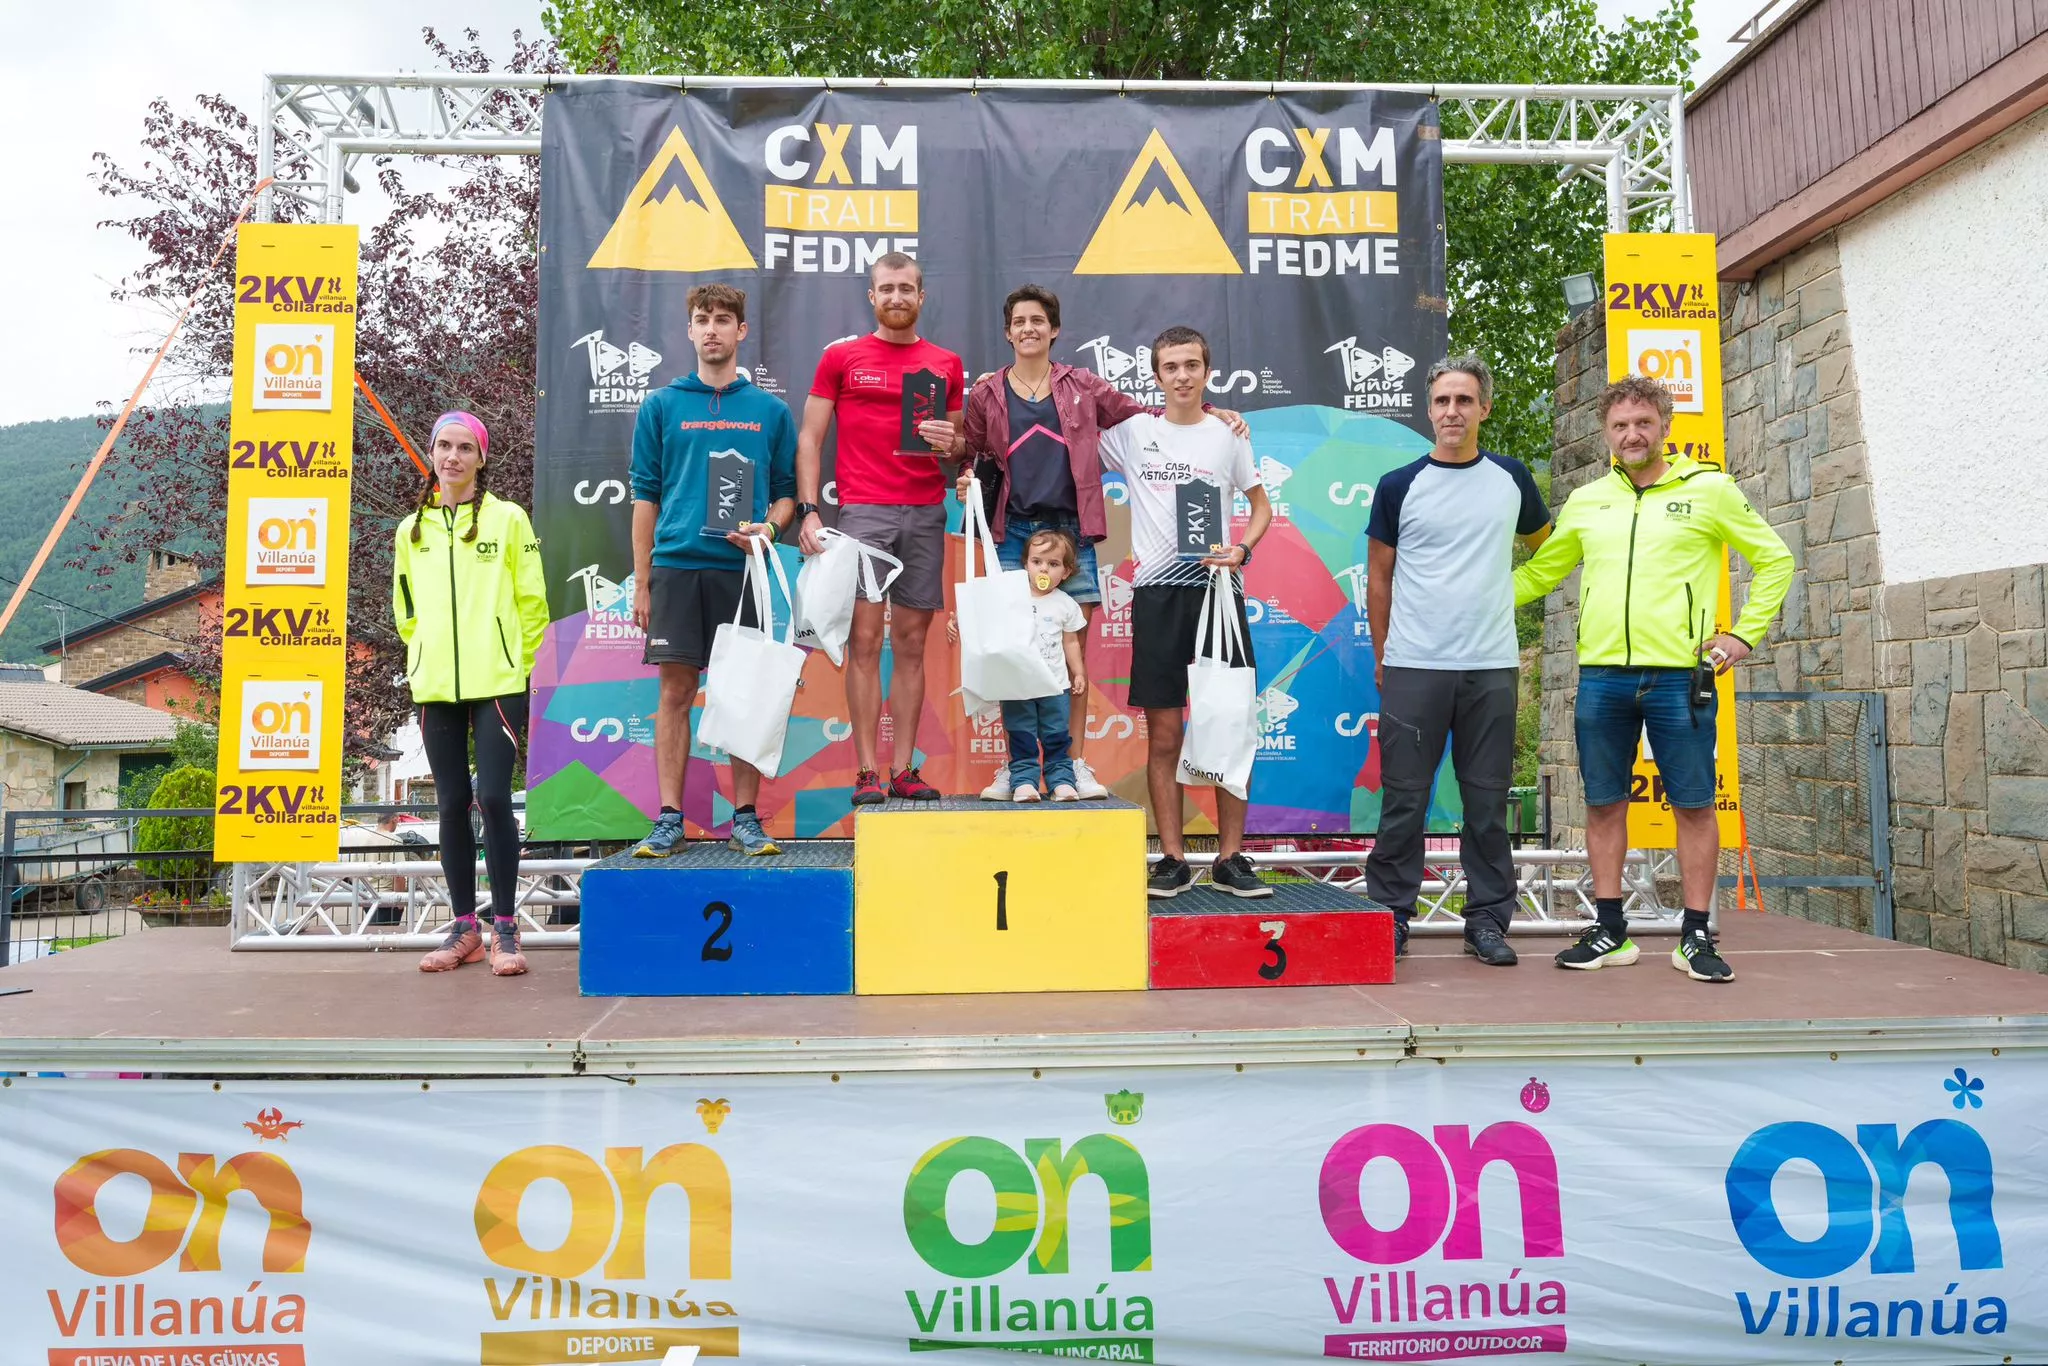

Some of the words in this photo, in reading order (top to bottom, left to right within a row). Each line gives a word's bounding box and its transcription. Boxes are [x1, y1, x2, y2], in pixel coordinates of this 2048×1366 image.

[765, 123, 918, 185] CXM
[1245, 127, 1397, 188] CXM
[779, 190, 906, 228] TRAIL
[1260, 197, 1386, 231] TRAIL
[1249, 238, 1400, 277] FEDME
[238, 275, 325, 304] 2KV
[1608, 283, 1688, 311] 2KV
[272, 300, 354, 314] collarada
[1641, 306, 1717, 319] collarada
[264, 343, 323, 376] on
[264, 376, 322, 389] Villanúa
[598, 372, 649, 388] años
[1354, 378, 1404, 393] años
[589, 388, 653, 404] FEDM
[1344, 393, 1412, 409] FEDME
[232, 440, 319, 469] 2KV
[1165, 462, 1191, 472] CASA
[266, 466, 348, 478] collarada
[258, 517, 317, 550] on
[1187, 501, 1205, 545] 2KV
[257, 551, 316, 564] Villanúa
[225, 608, 313, 638] 2KV
[595, 608, 633, 622] año
[260, 633, 342, 647] collarada
[585, 624, 647, 639] FEDM
[252, 701, 311, 734] on
[251, 735, 310, 748] Villanúa
[971, 738, 1007, 753] FED
[1256, 735, 1297, 750] DME
[218, 785, 307, 815] 2KV
[254, 811, 337, 825] collarada
[993, 871, 1009, 931] 1
[701, 901, 733, 962] 2
[1257, 920, 1287, 980] 3
[903, 1133, 1152, 1279] on
[1318, 1120, 1565, 1265] on
[1725, 1118, 2004, 1280] on
[54, 1147, 312, 1277] on
[474, 1142, 732, 1279] on
[46, 1280, 306, 1338] Villanúa
[483, 1275, 738, 1321] Villanúa
[904, 1283, 1155, 1333] Villanúa
[1323, 1268, 1567, 1324] Villanúa
[1734, 1282, 2008, 1338] Villanúa
[209, 1350, 280, 1366] GÜIXAS
[566, 1336, 654, 1356] DEPORTE
[1348, 1338, 1450, 1357] TERRITORIO
[1454, 1335, 1543, 1352] OUTDOOR
